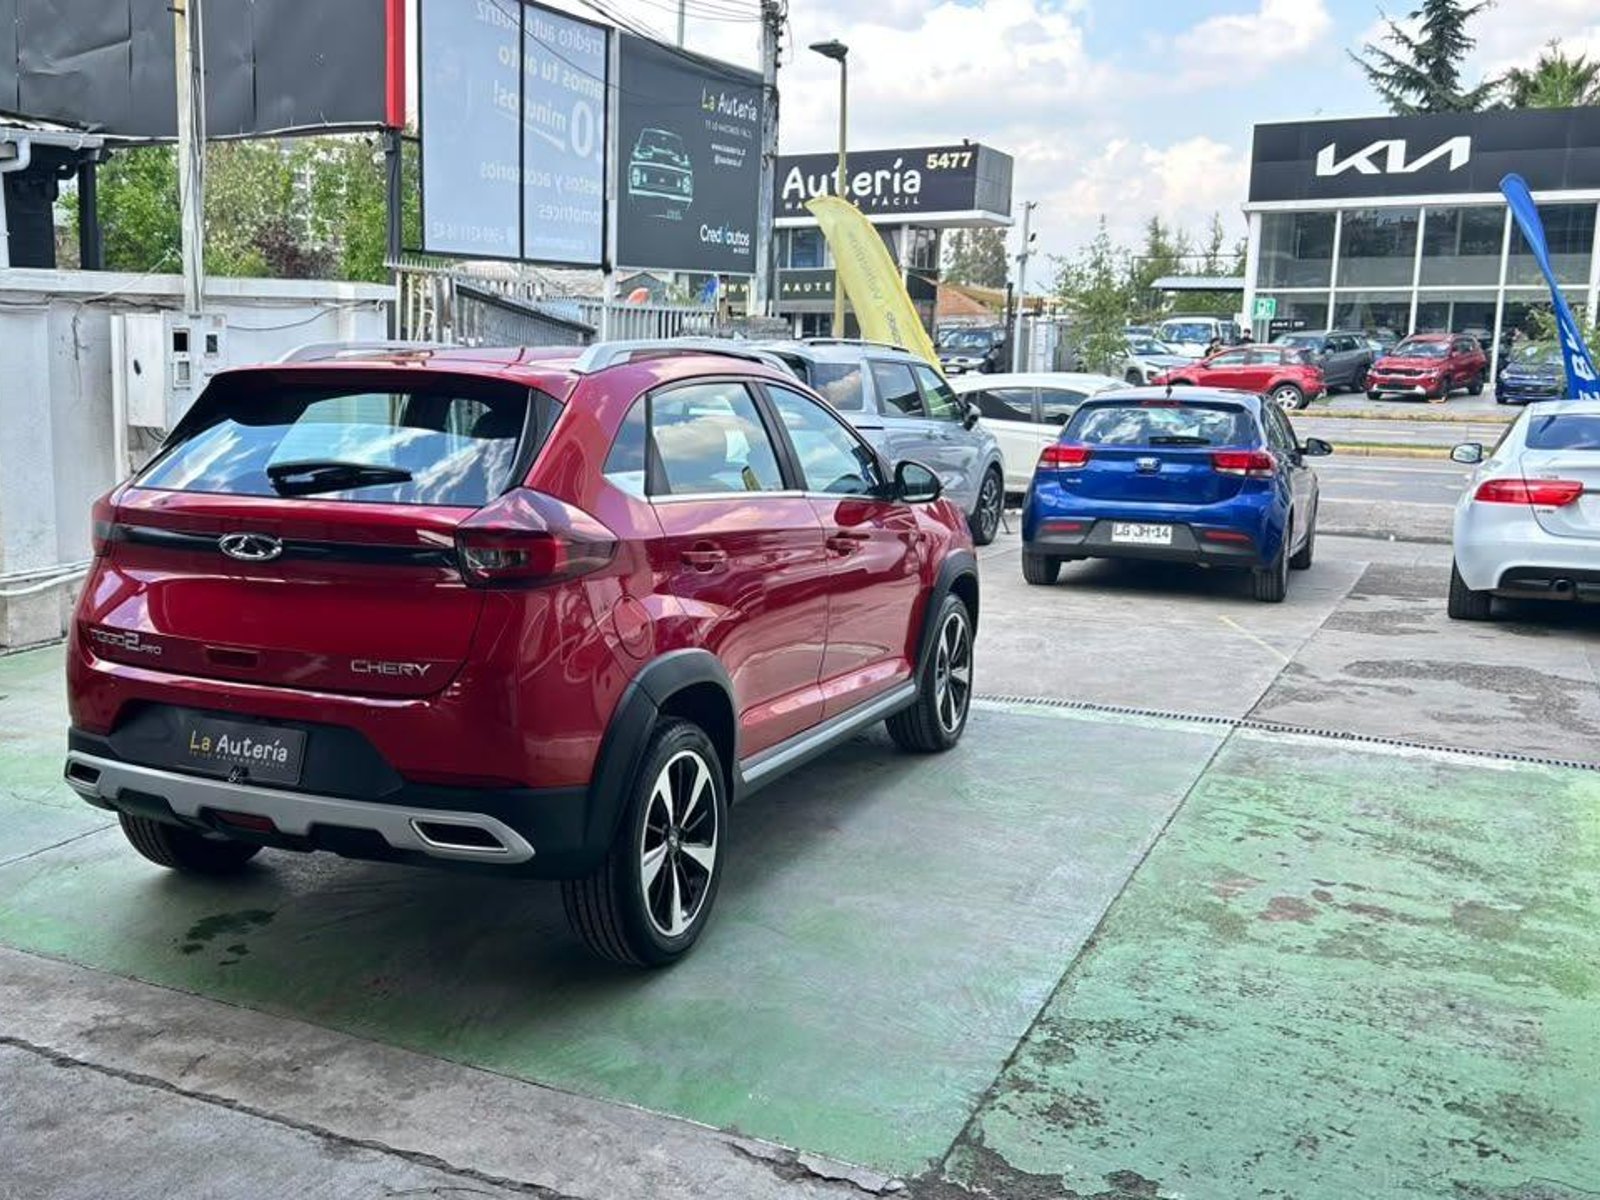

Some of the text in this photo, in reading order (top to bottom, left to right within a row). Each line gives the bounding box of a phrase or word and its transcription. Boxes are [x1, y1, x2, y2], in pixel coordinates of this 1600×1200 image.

[702, 87, 715, 112] La
[926, 151, 973, 169] 5477
[351, 659, 432, 677] CHERY
[190, 730, 211, 752] La
[216, 734, 288, 763] Autería
